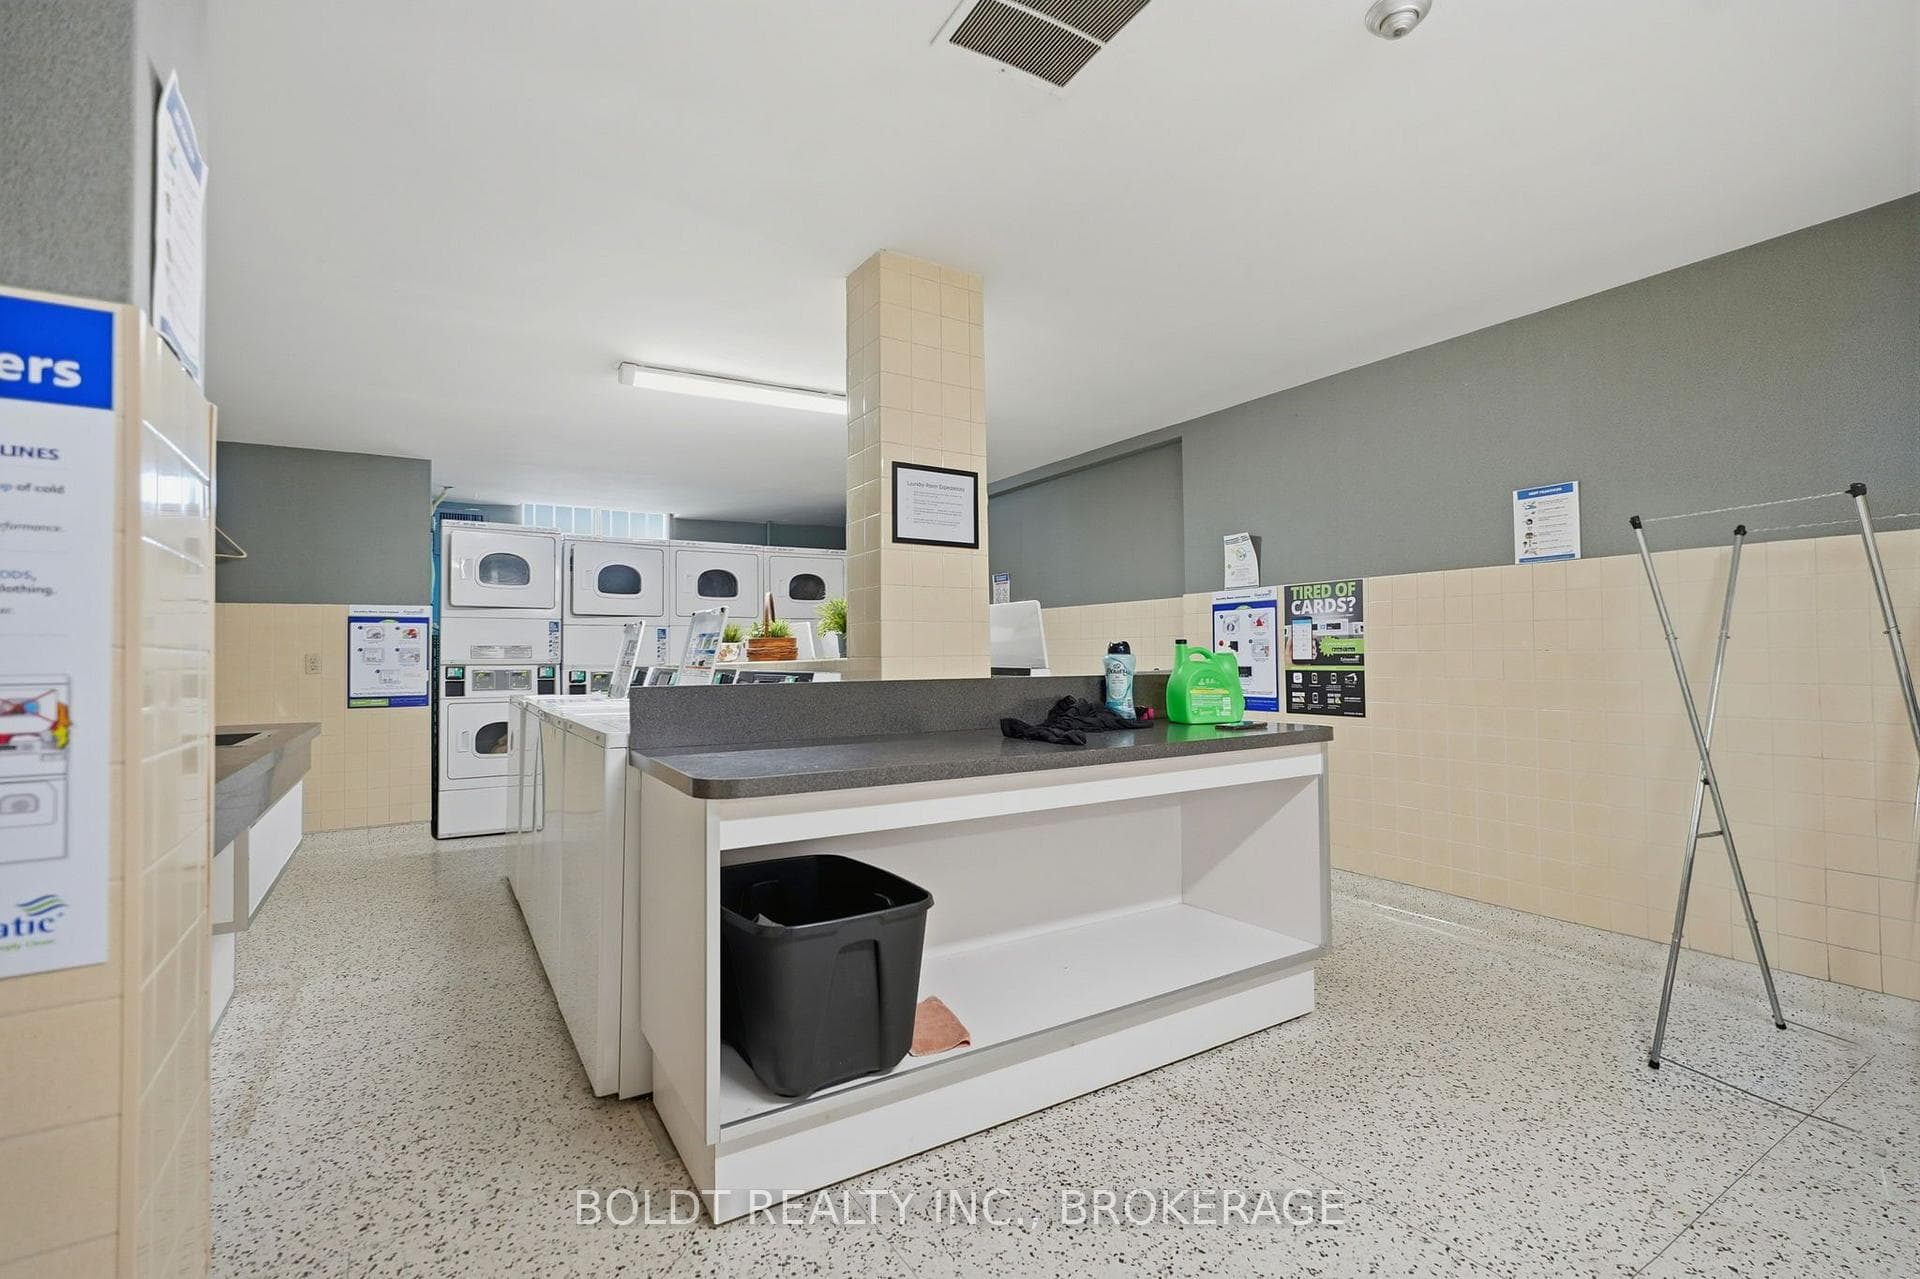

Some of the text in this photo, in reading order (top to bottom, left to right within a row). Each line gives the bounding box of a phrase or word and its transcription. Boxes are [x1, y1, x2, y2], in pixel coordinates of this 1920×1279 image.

[0, 352, 82, 388] ers
[0, 444, 60, 461] LINES
[16, 482, 31, 492] of
[34, 485, 66, 494] cold
[1290, 581, 1356, 600] TIRED OF
[1291, 596, 1356, 615] CARDS?
